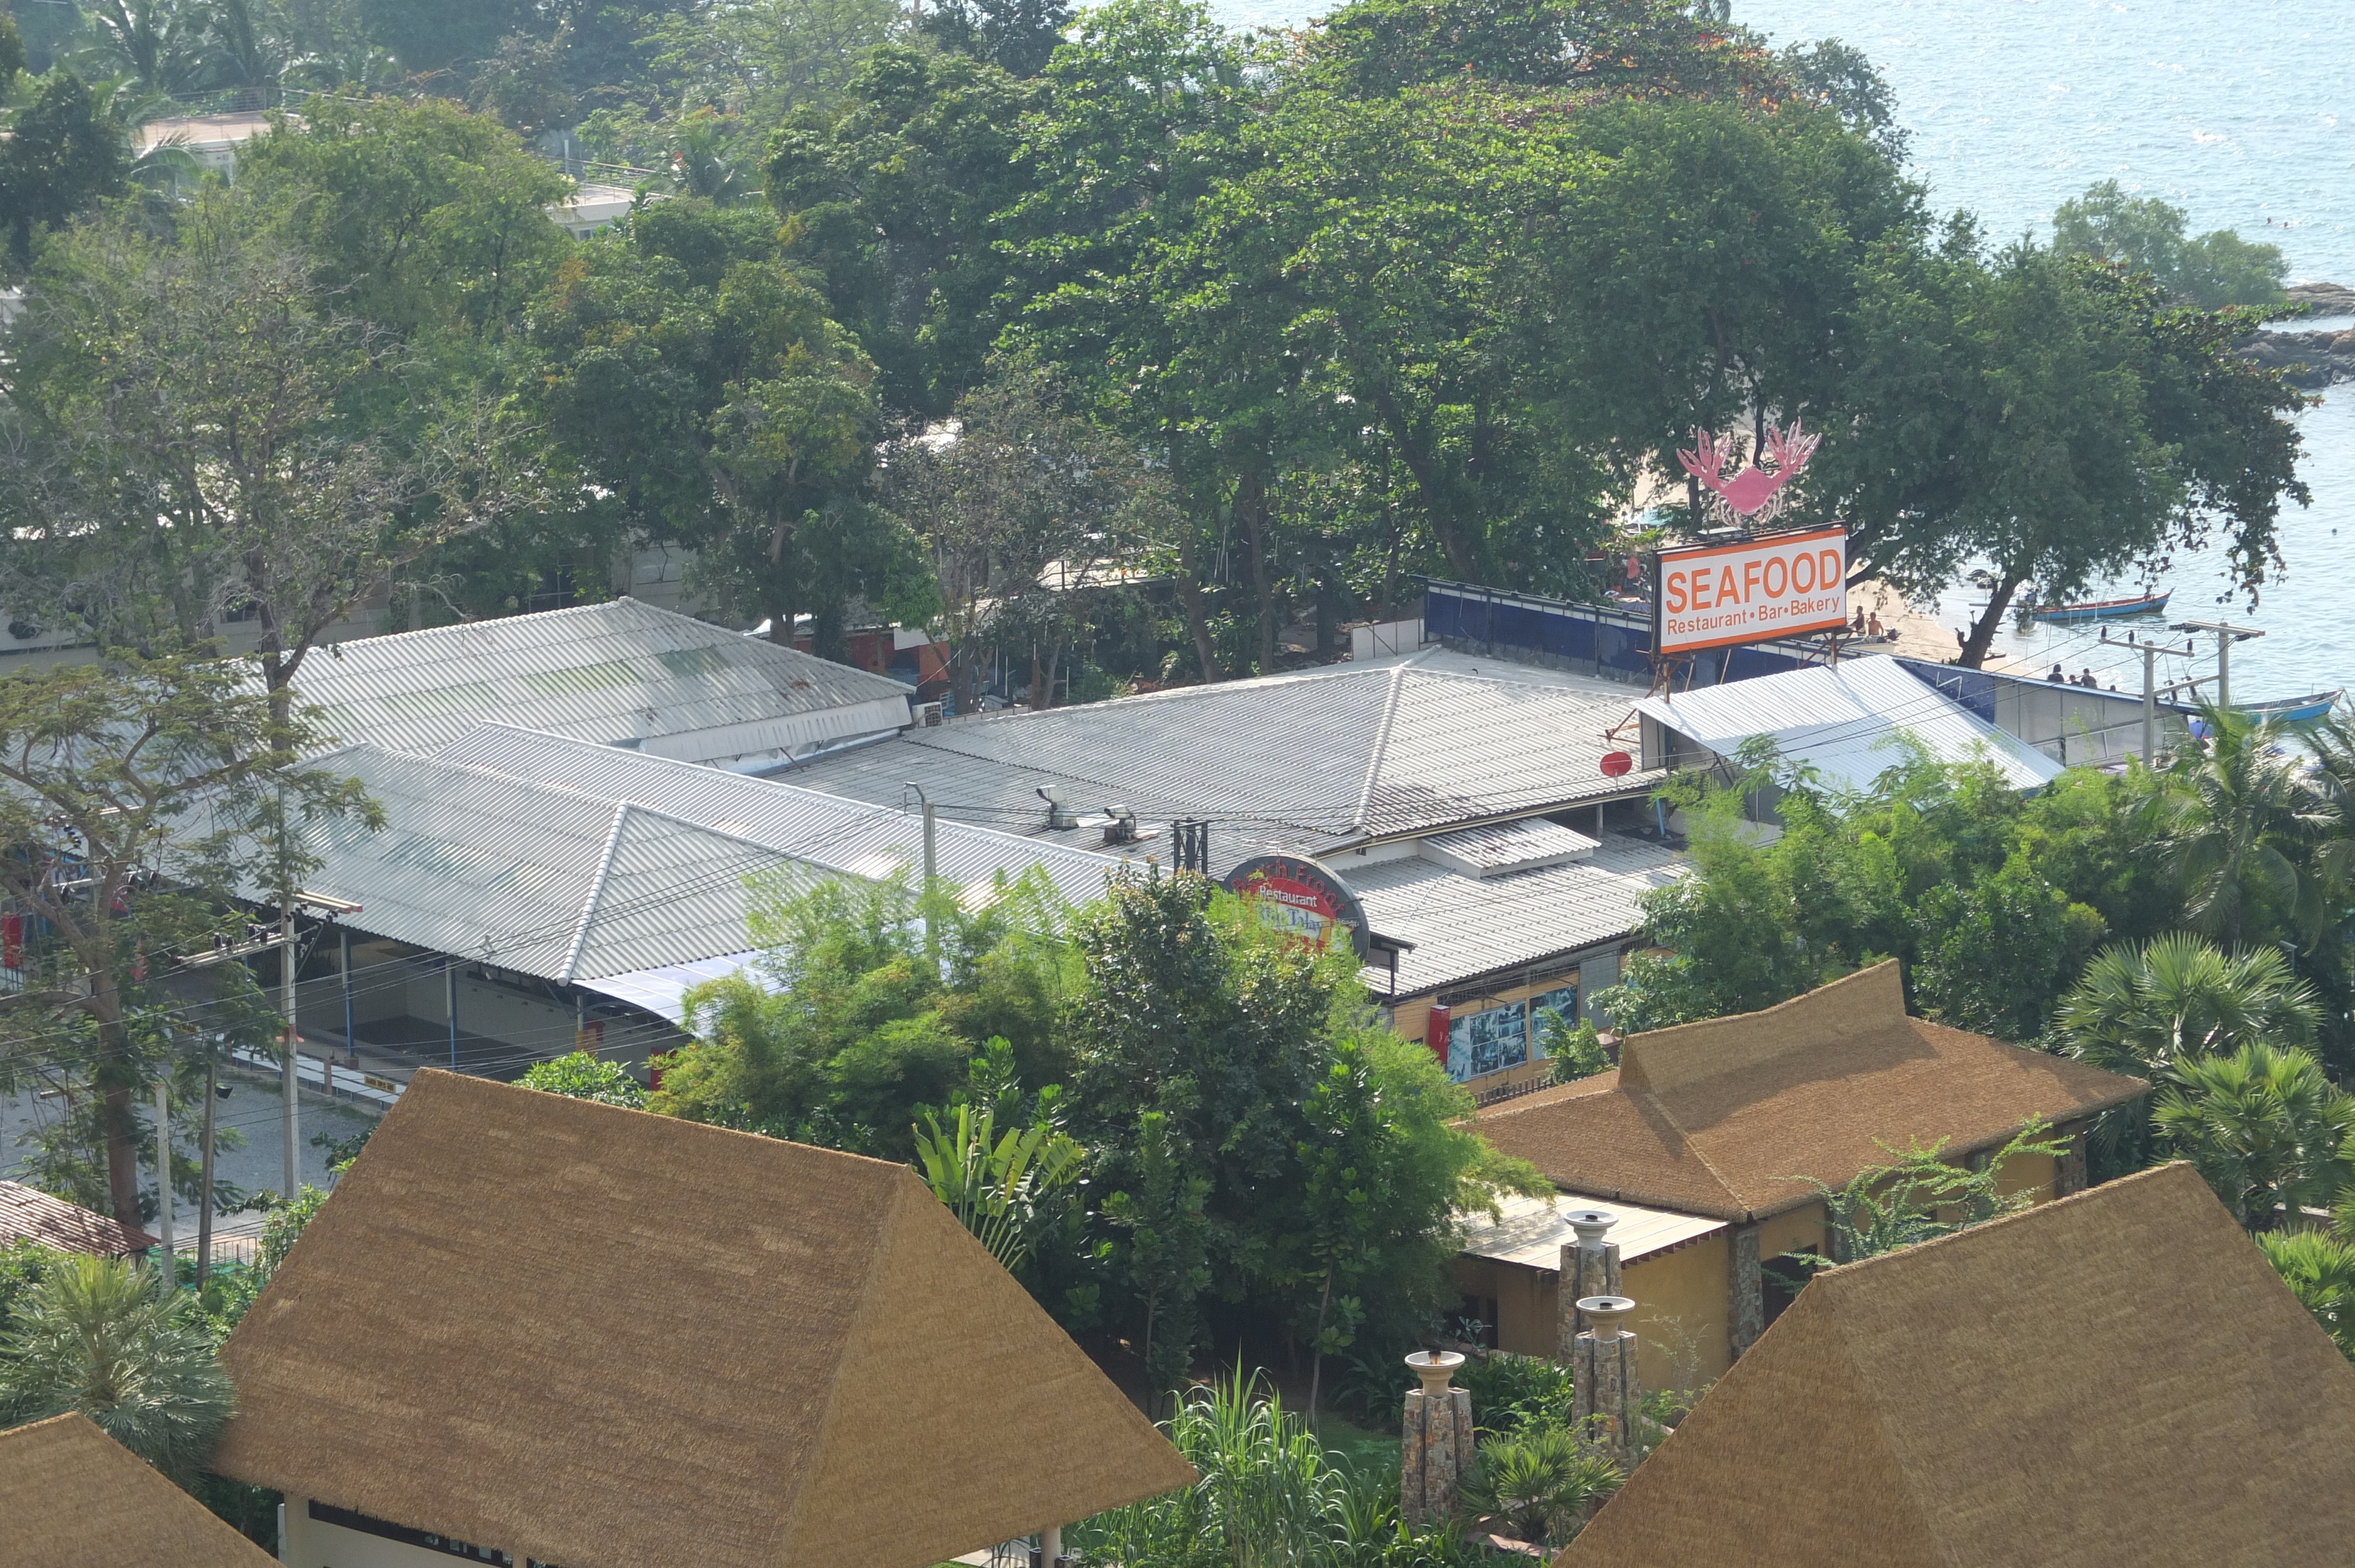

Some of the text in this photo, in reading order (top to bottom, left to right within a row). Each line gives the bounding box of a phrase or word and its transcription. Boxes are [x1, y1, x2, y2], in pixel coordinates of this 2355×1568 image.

[1666, 549, 1841, 614] SEAFOOD
[1667, 596, 1840, 635] Restaurant Bar Bakery
[1258, 885, 1318, 907] Restaurant
